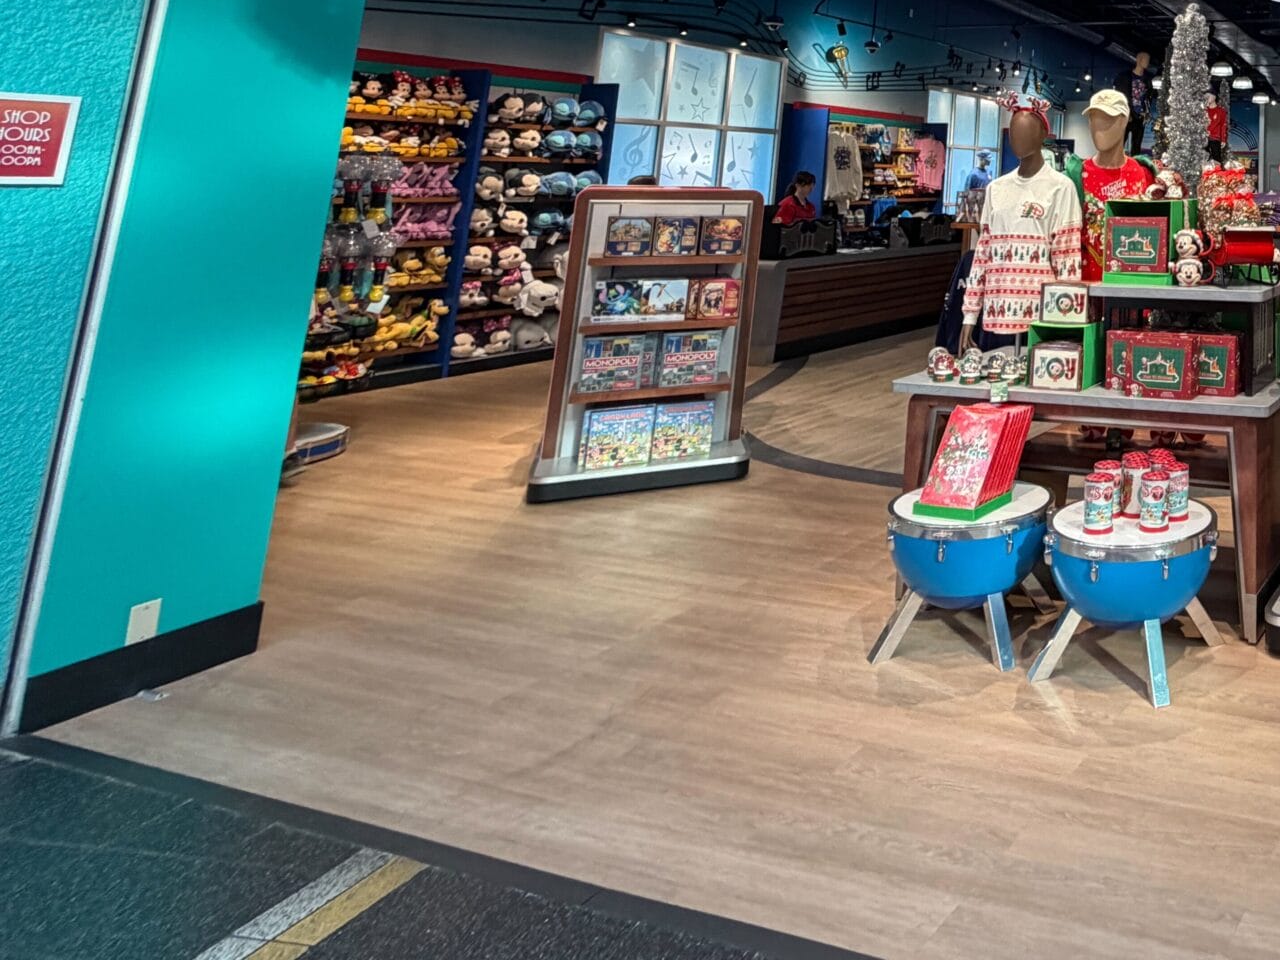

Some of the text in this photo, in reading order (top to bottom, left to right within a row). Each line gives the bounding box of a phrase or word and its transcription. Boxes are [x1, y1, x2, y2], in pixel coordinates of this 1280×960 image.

[1, 109, 51, 125] SHOP
[1044, 291, 1086, 316] JOY
[584, 356, 638, 369] MONOPOLY
[665, 352, 715, 363] MONOPOLY
[1034, 356, 1077, 382] JOY
